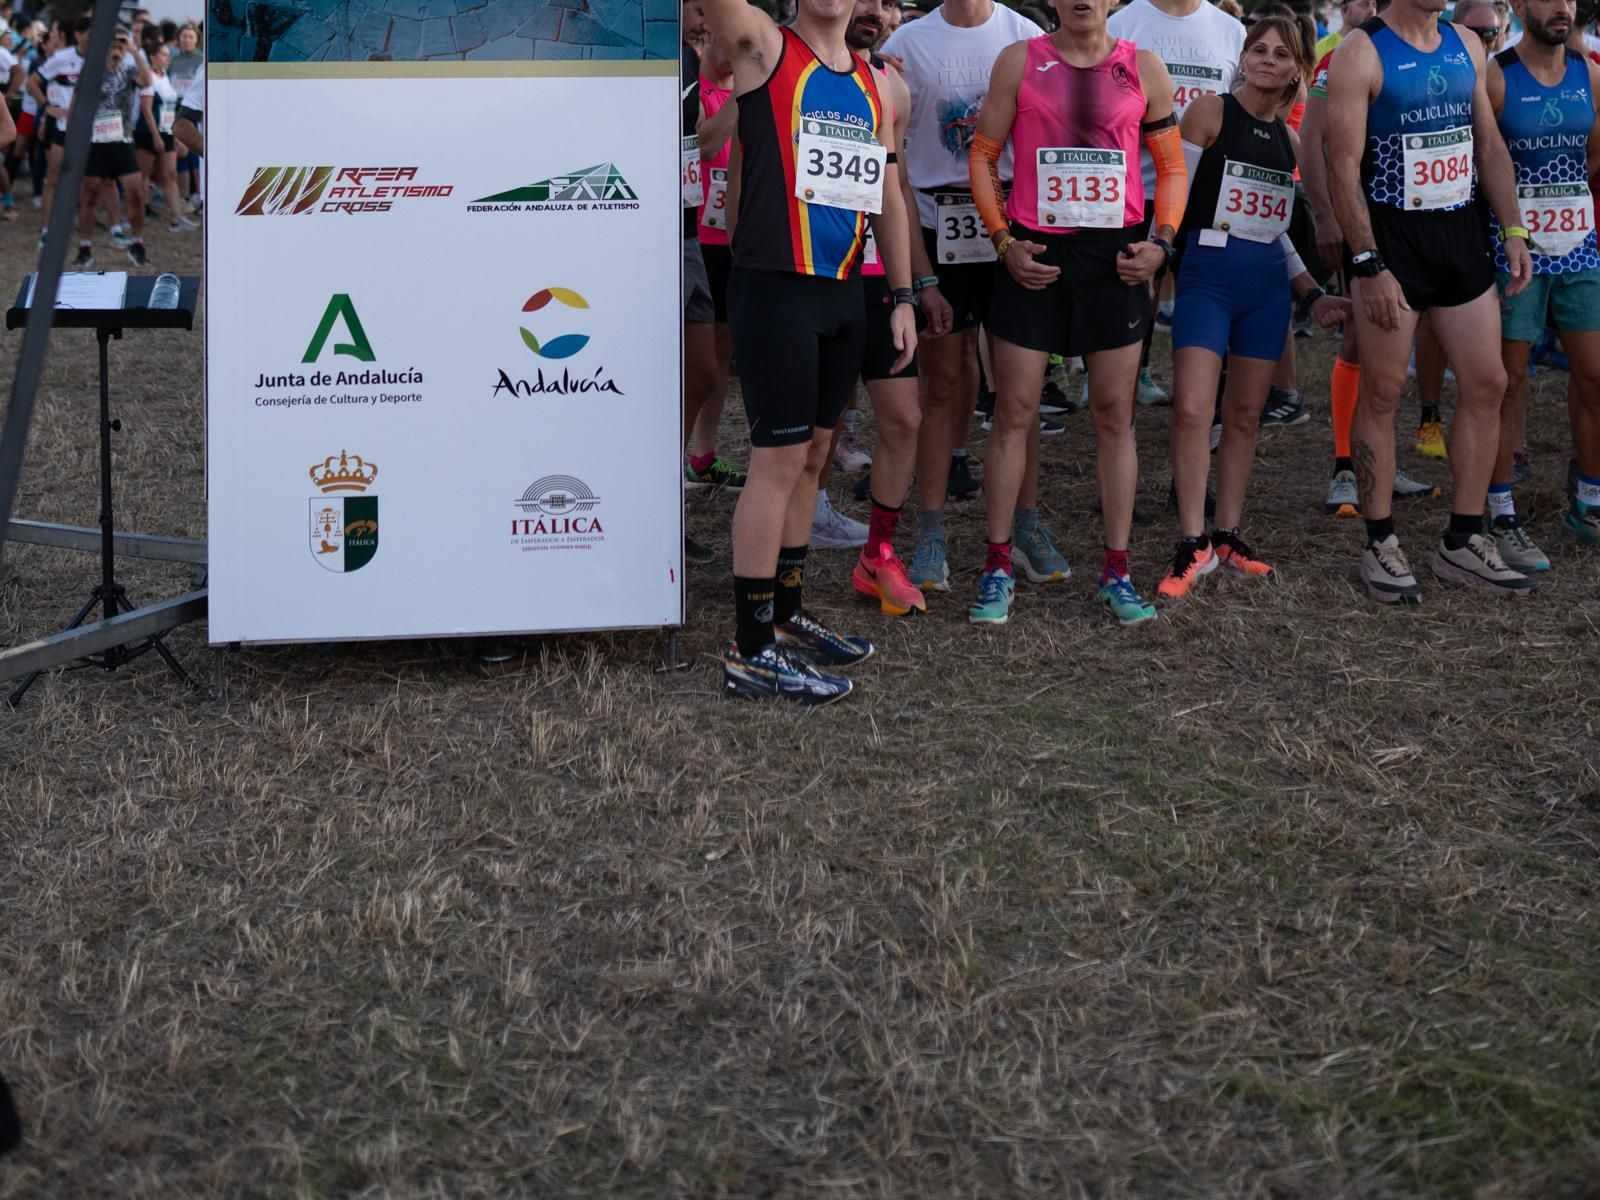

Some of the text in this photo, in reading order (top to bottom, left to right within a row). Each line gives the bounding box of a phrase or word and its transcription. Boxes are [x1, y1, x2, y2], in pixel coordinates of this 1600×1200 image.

[804, 110, 841, 121] CICLOS
[1254, 128, 1271, 140] FILA
[1063, 150, 1104, 162] ITÁLICA
[336, 167, 418, 186] RFEA
[806, 148, 881, 185] 3349
[1413, 154, 1469, 186] 3084
[328, 186, 454, 198] ATLETISMO
[1047, 176, 1120, 202] 3133
[320, 201, 393, 215] CROSS
[467, 202, 521, 213] FEDERACIÓN
[592, 202, 640, 210] ATLETISMO
[1226, 188, 1287, 222] 3354
[1525, 207, 1589, 233] 3281
[254, 367, 423, 388] Junta de Andalucía
[492, 366, 625, 398] Andalucía
[255, 392, 422, 408] Consejería de Cultura y Deporte
[511, 514, 604, 536] ITÁLICA
